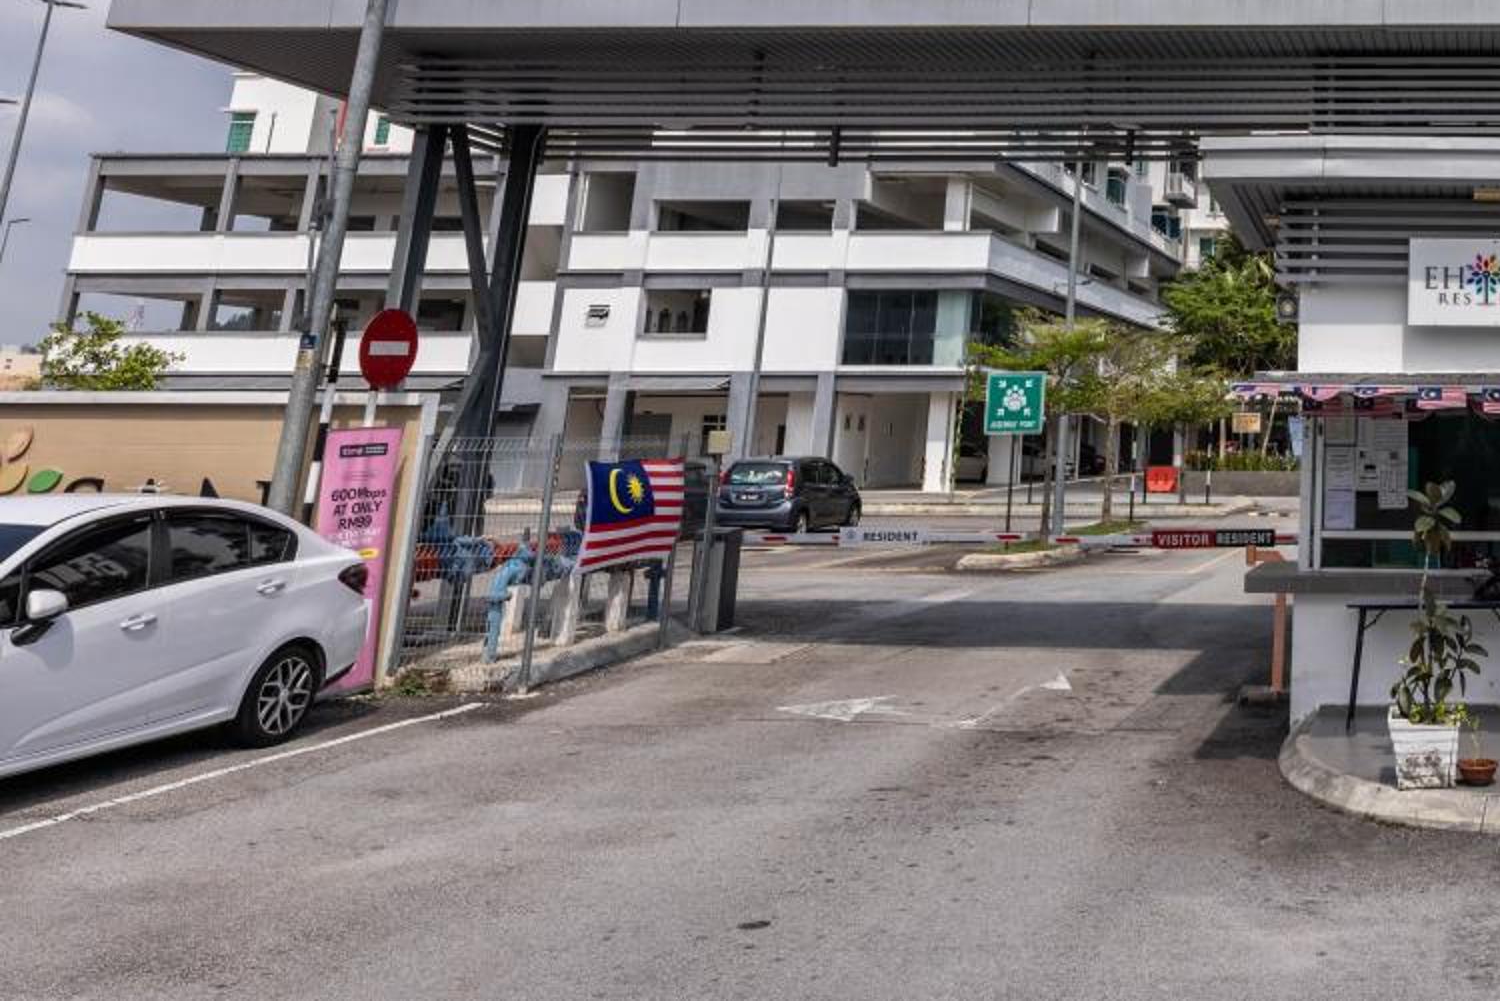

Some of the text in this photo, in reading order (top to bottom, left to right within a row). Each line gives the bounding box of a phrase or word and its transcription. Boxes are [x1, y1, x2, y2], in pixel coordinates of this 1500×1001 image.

[333, 500, 383, 517] AT ONLY
[863, 531, 918, 541] RESIDENT
[1157, 531, 1273, 545] VISITOR RESIDENT
